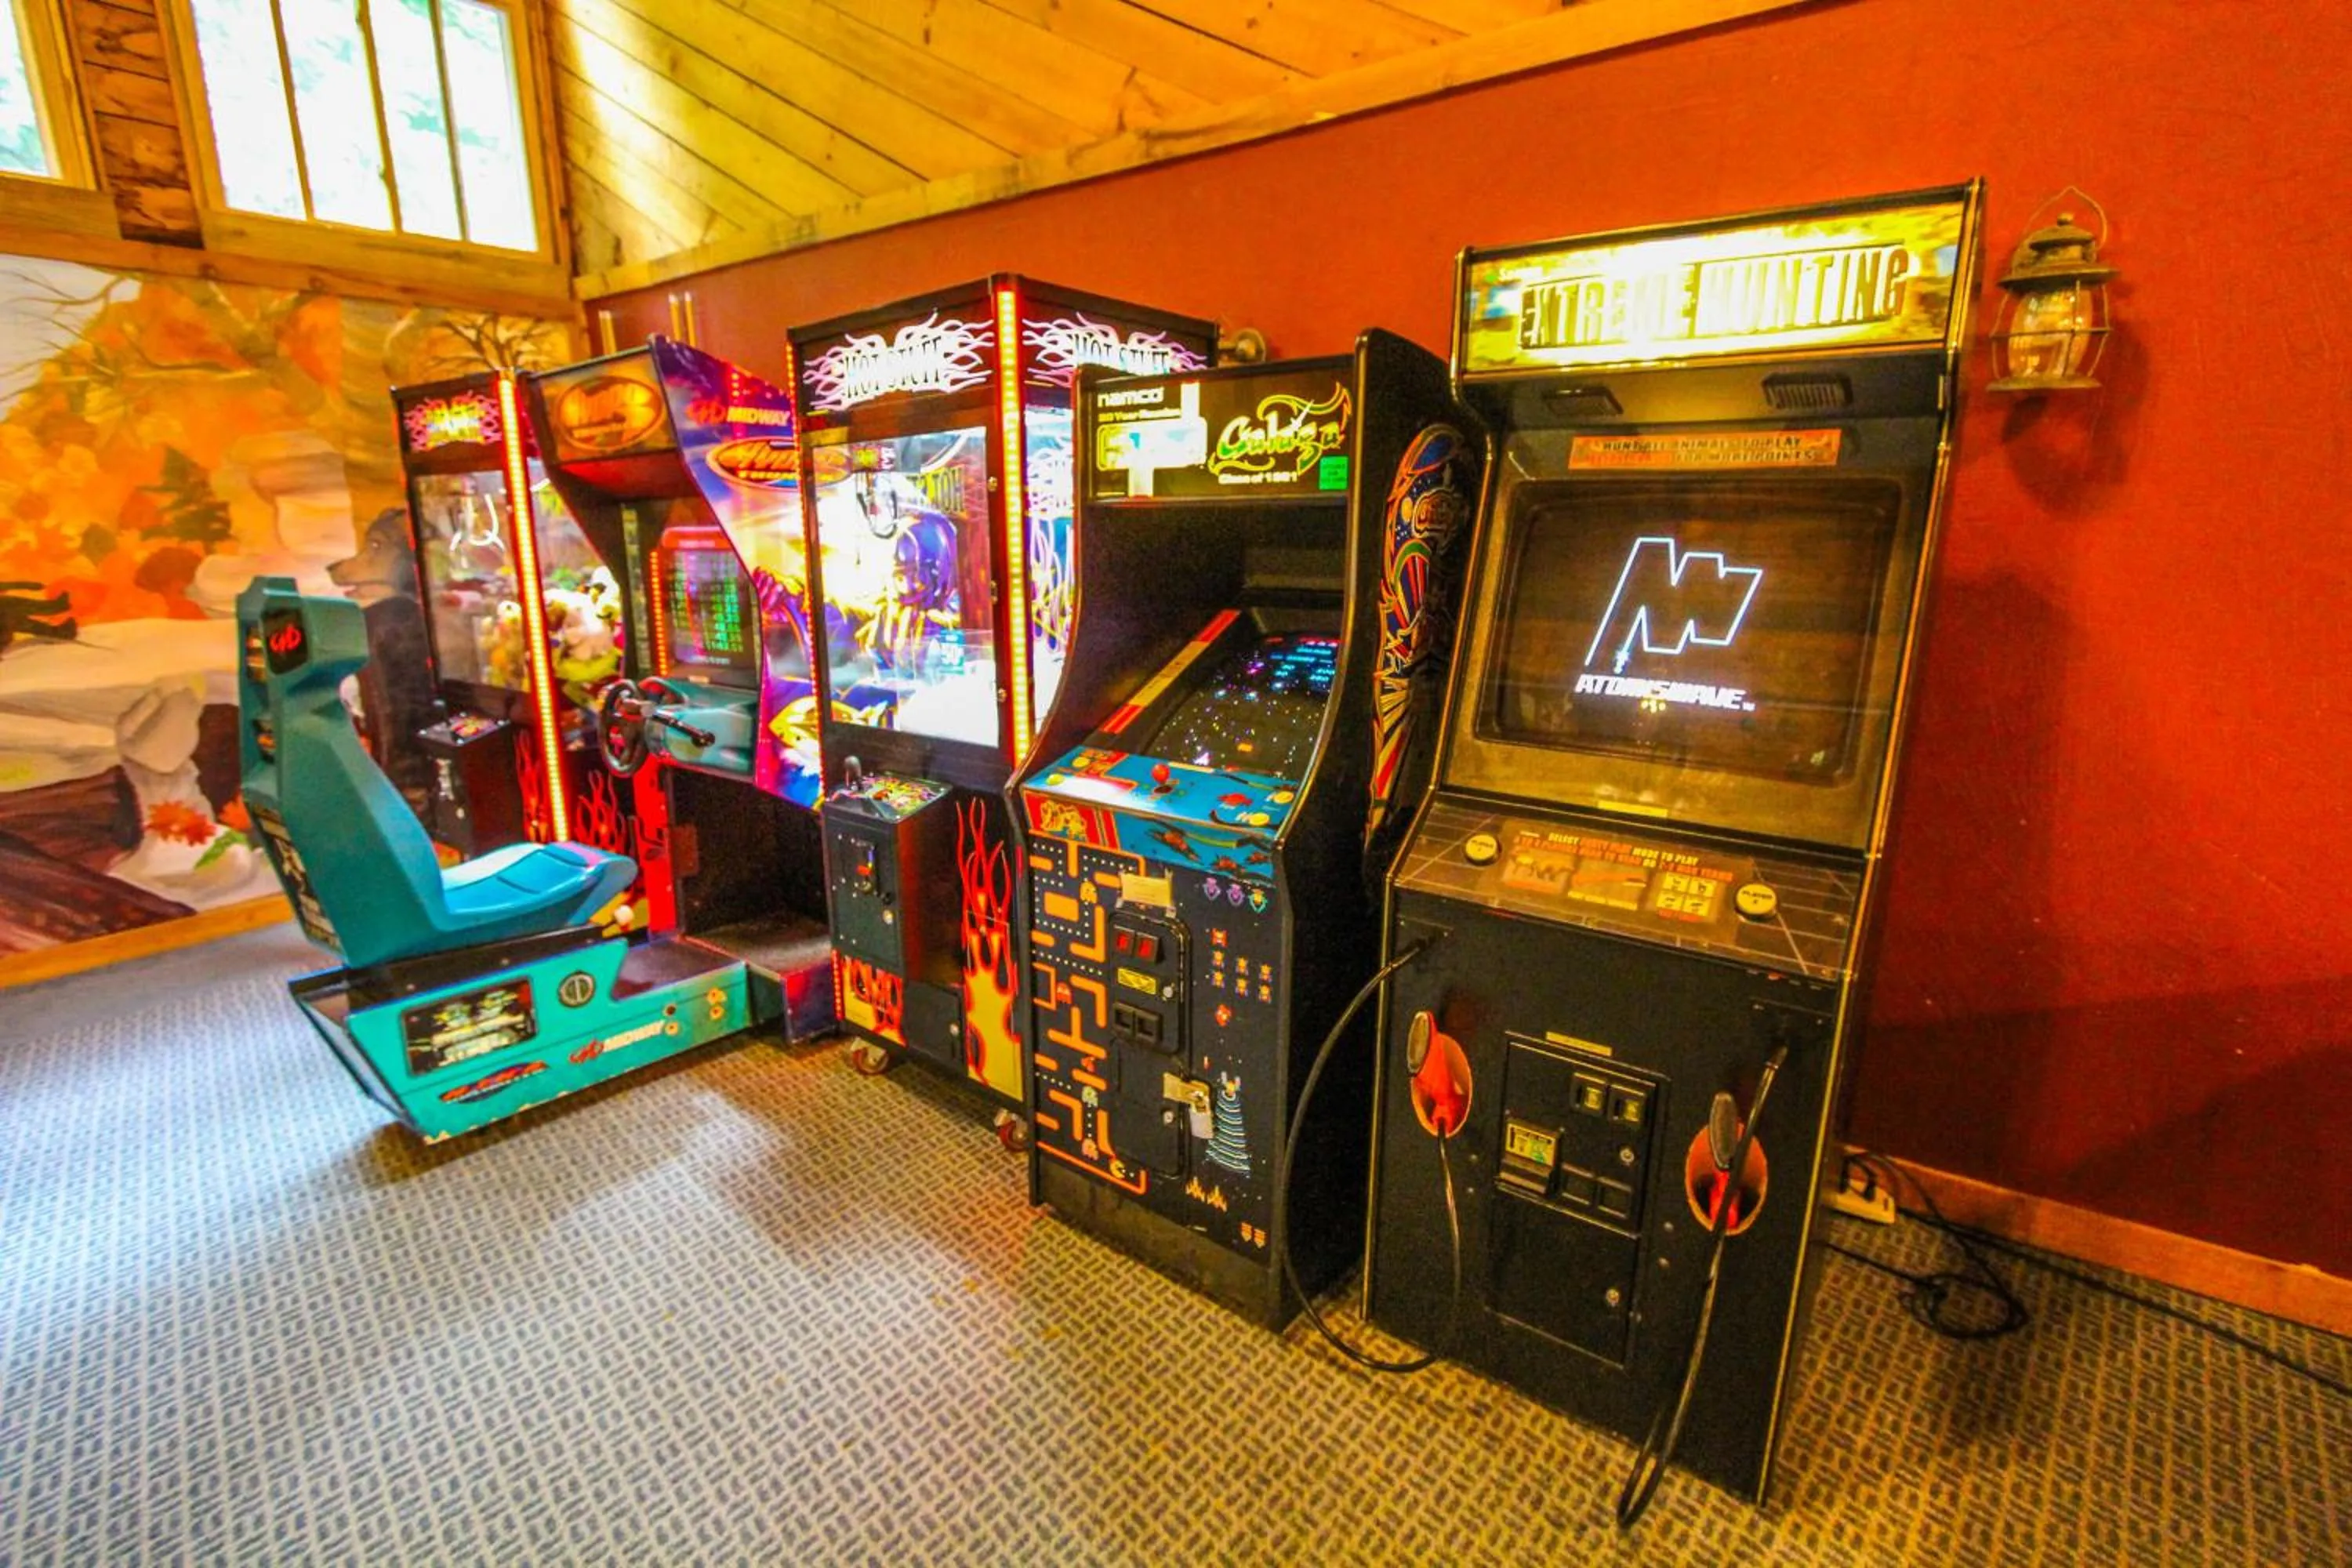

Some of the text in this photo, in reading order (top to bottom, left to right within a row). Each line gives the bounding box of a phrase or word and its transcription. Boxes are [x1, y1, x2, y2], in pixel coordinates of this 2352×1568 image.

[1518, 246, 1911, 350] EXTREME HUNTING
[727, 406, 791, 426] MIDWAY
[1574, 673, 1747, 710] ATOMISWAVE
